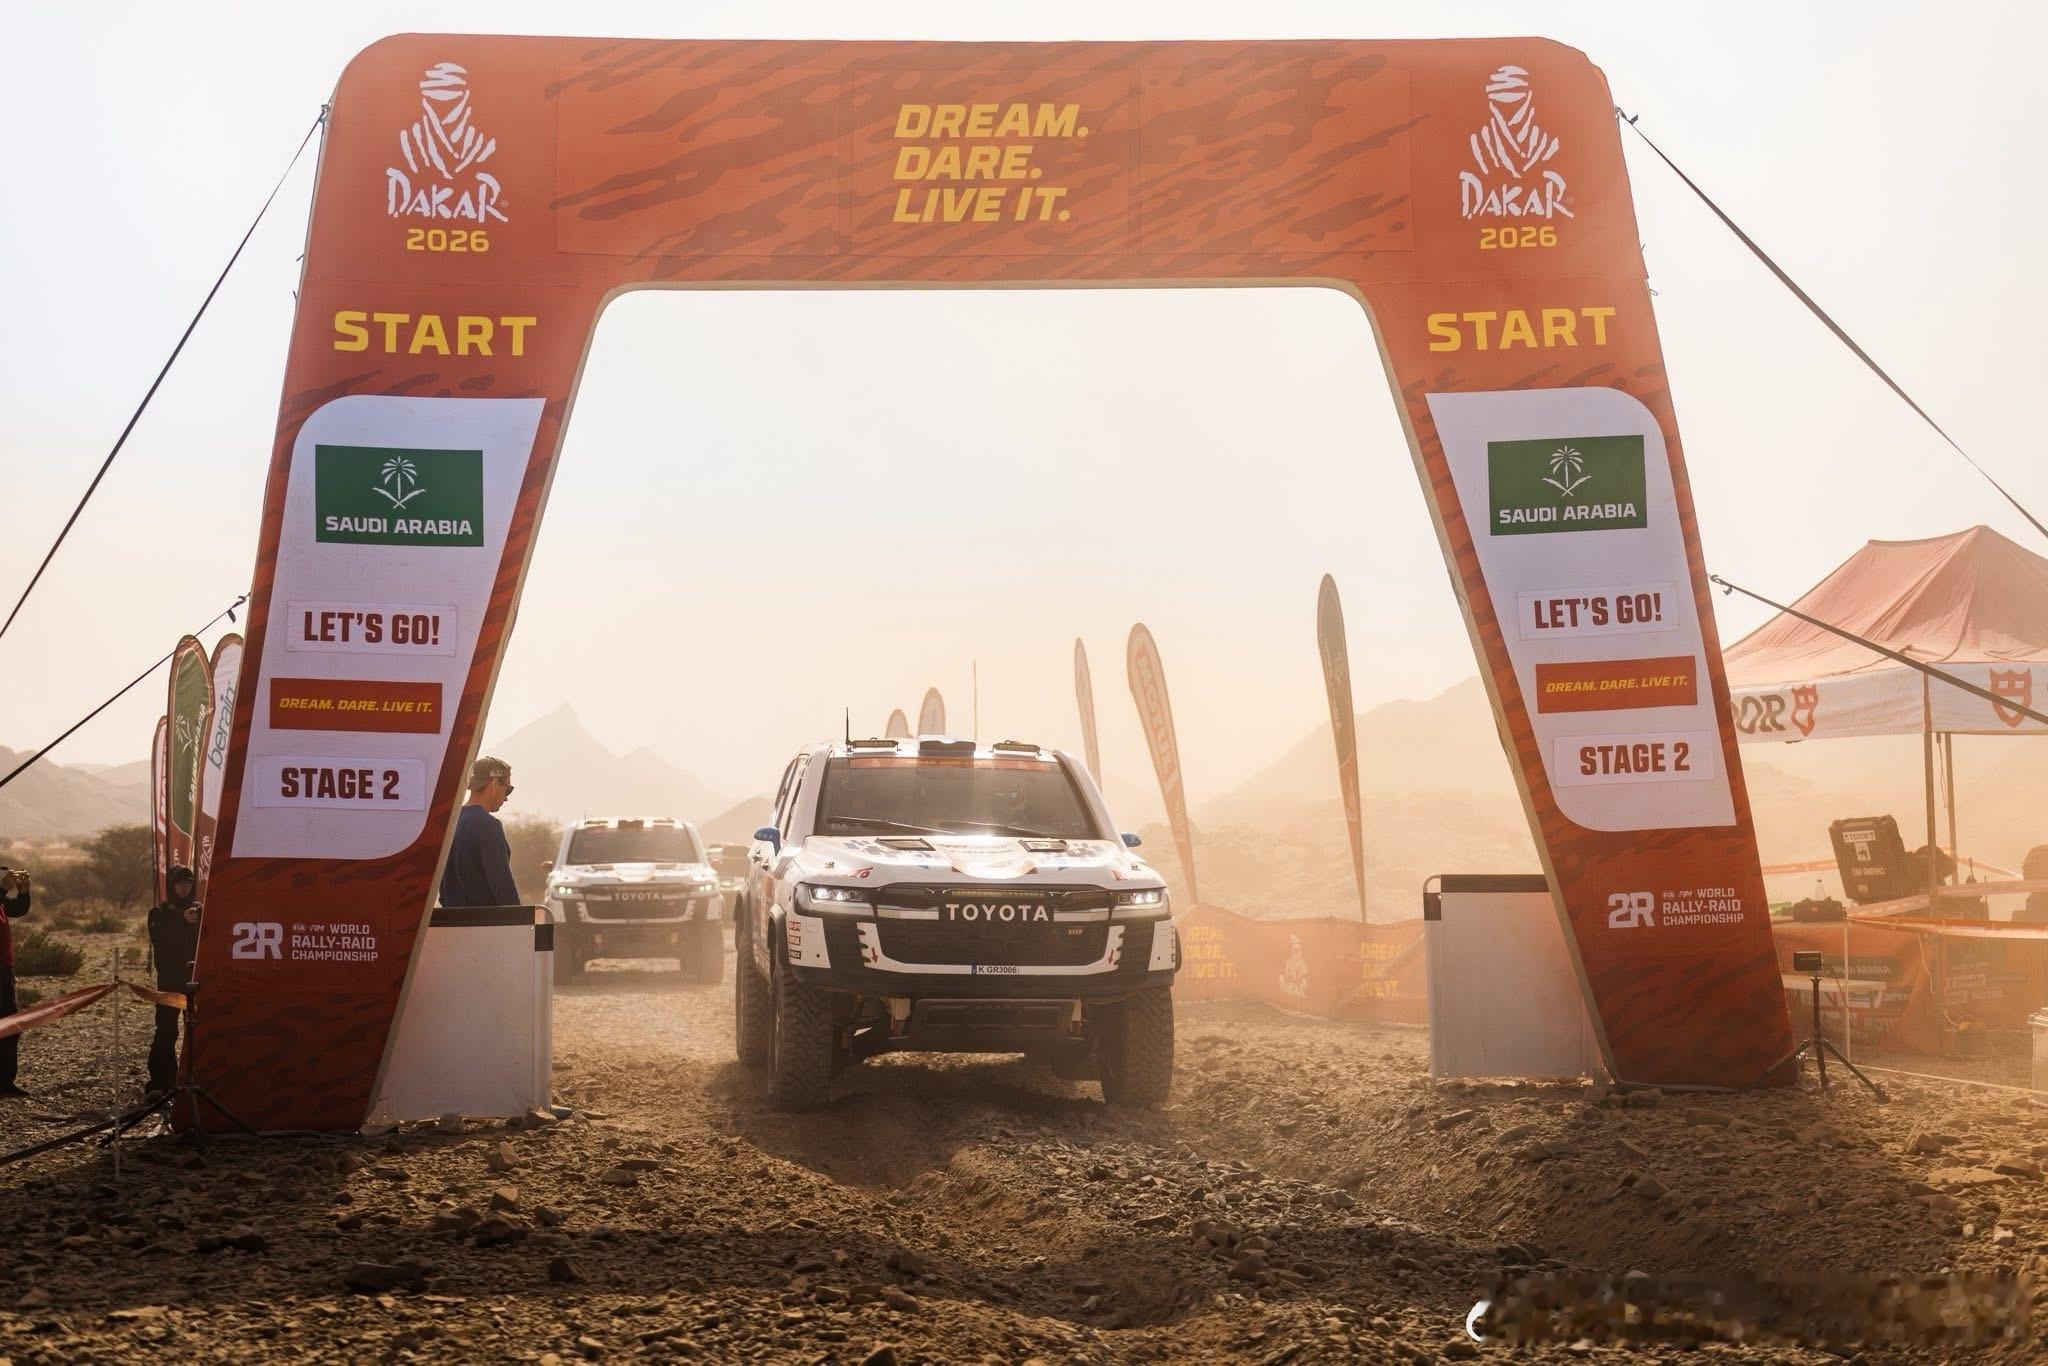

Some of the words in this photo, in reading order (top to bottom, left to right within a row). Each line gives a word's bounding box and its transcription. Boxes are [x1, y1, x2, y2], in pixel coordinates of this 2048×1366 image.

[894, 104, 1088, 137] DREAM.
[893, 146, 1042, 180] DARE.
[386, 168, 508, 222] DAKAR
[893, 187, 1006, 223] LIVE
[1014, 187, 1070, 221] IT.
[1459, 170, 1574, 219] DAKAR
[407, 228, 489, 252] 2026
[1480, 226, 1557, 249] 2026
[334, 311, 537, 356] START
[1427, 306, 1616, 352] START
[1499, 507, 1557, 524] SAUDI
[1562, 503, 1637, 520] ARABIA
[326, 516, 387, 533] SAUDI
[394, 518, 473, 535] ARABIA
[1533, 597, 1609, 629] LET'S
[1615, 592, 1661, 624] GO!
[304, 611, 383, 643] LET'S
[391, 614, 440, 645] GO!
[1545, 680, 1597, 693] DREAM.
[1600, 678, 1638, 691] DARE.
[1642, 676, 1670, 688] LIVE
[1673, 675, 1688, 686] IT.
[280, 697, 334, 710] DREAM.
[338, 699, 379, 711] DARE.
[383, 701, 416, 712] LIVE
[416, 702, 432, 713] IT.
[1730, 695, 1786, 735] OR
[1579, 743, 1666, 775] STAGE
[1673, 742, 1690, 771] 2
[281, 767, 374, 799] STAGE
[383, 770, 400, 800] 2
[616, 892, 660, 900] TOYOTA
[1697, 888, 1735, 898] WORLD
[946, 904, 1049, 921] TOYOTA
[1662, 899, 1741, 914] RALLY-RAID
[330, 923, 370, 935] WORLD
[1663, 913, 1744, 926] CHAMPIONSHIP
[291, 935, 375, 950] RALLY-RAID
[291, 950, 378, 962] CHAMPIONSHIP
